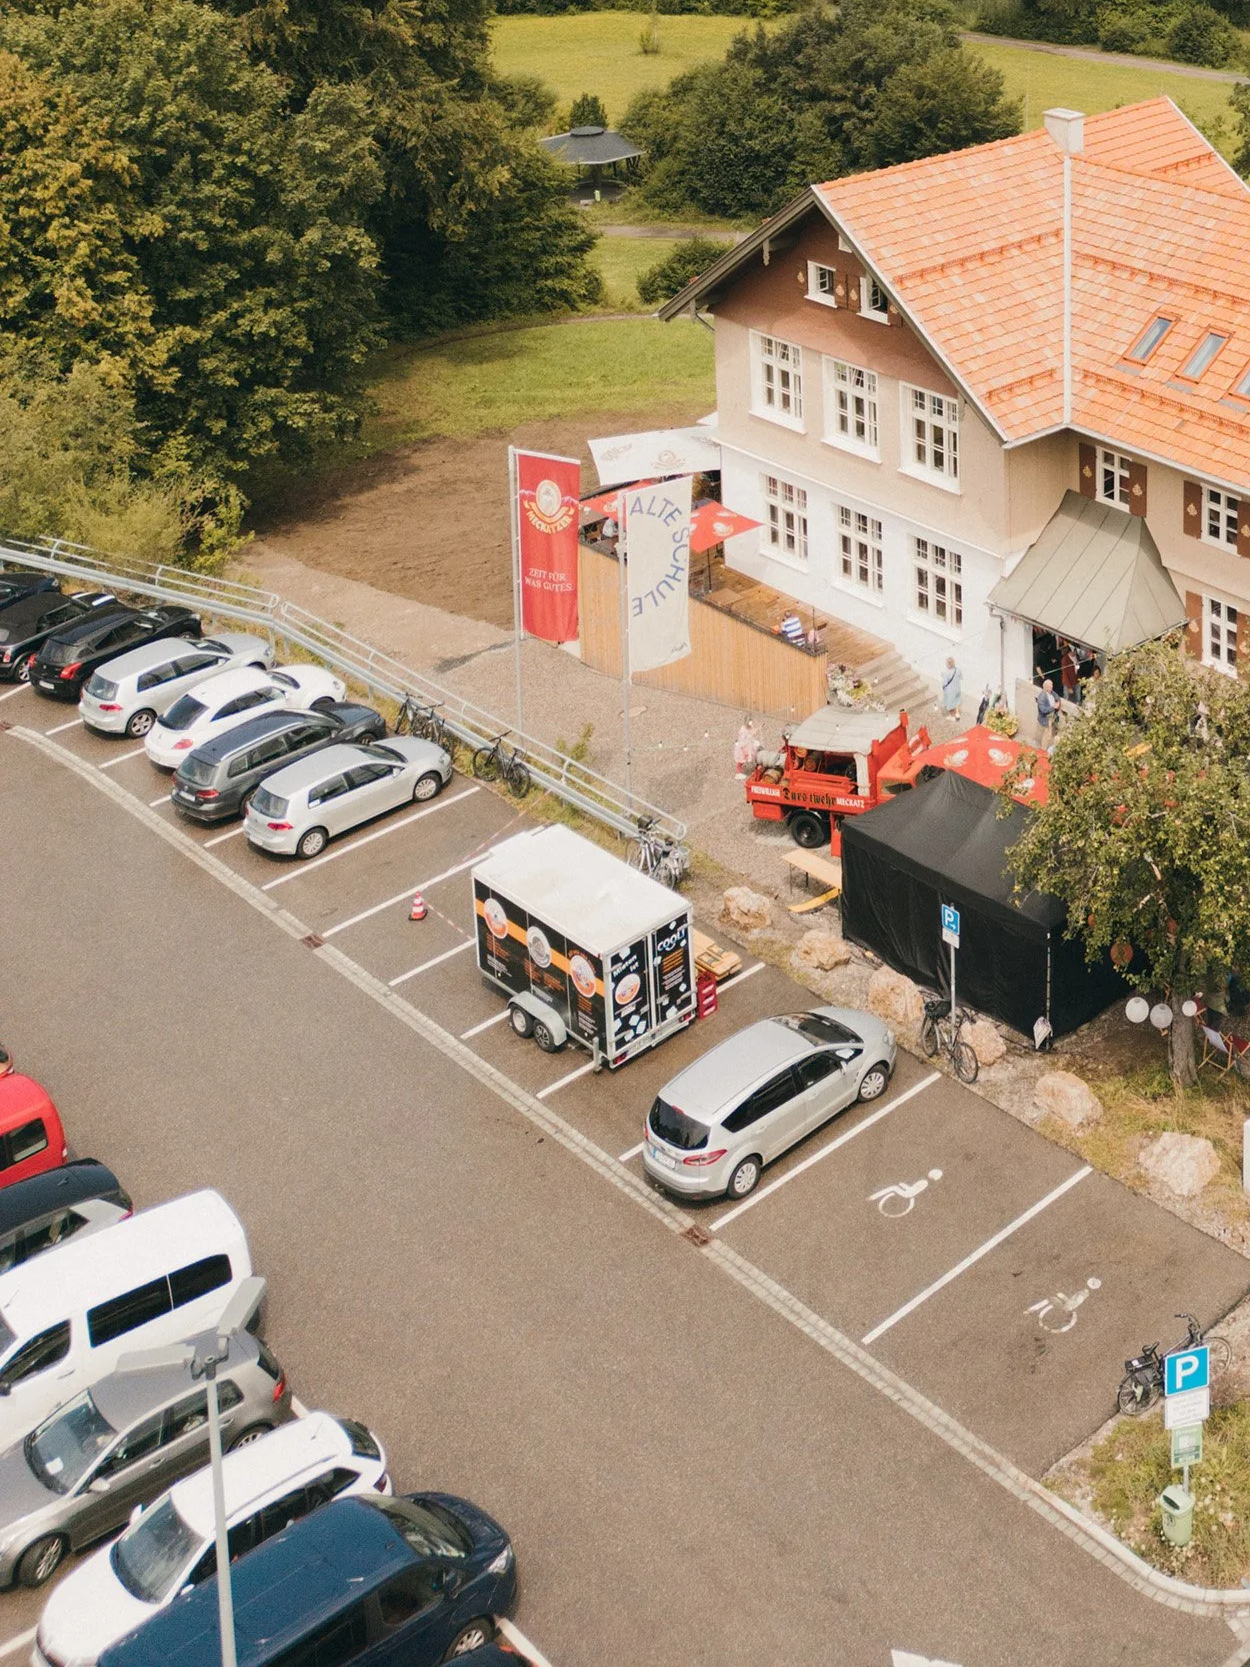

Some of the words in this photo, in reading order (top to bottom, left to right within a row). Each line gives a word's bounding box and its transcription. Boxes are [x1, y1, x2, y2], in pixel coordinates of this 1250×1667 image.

[630, 495, 682, 527] ALTE
[525, 576, 542, 588] WAS
[529, 567, 547, 578] ZEIT
[632, 527, 690, 617] SCHULE
[945, 909, 954, 925] P
[1175, 1355, 1199, 1390] P
